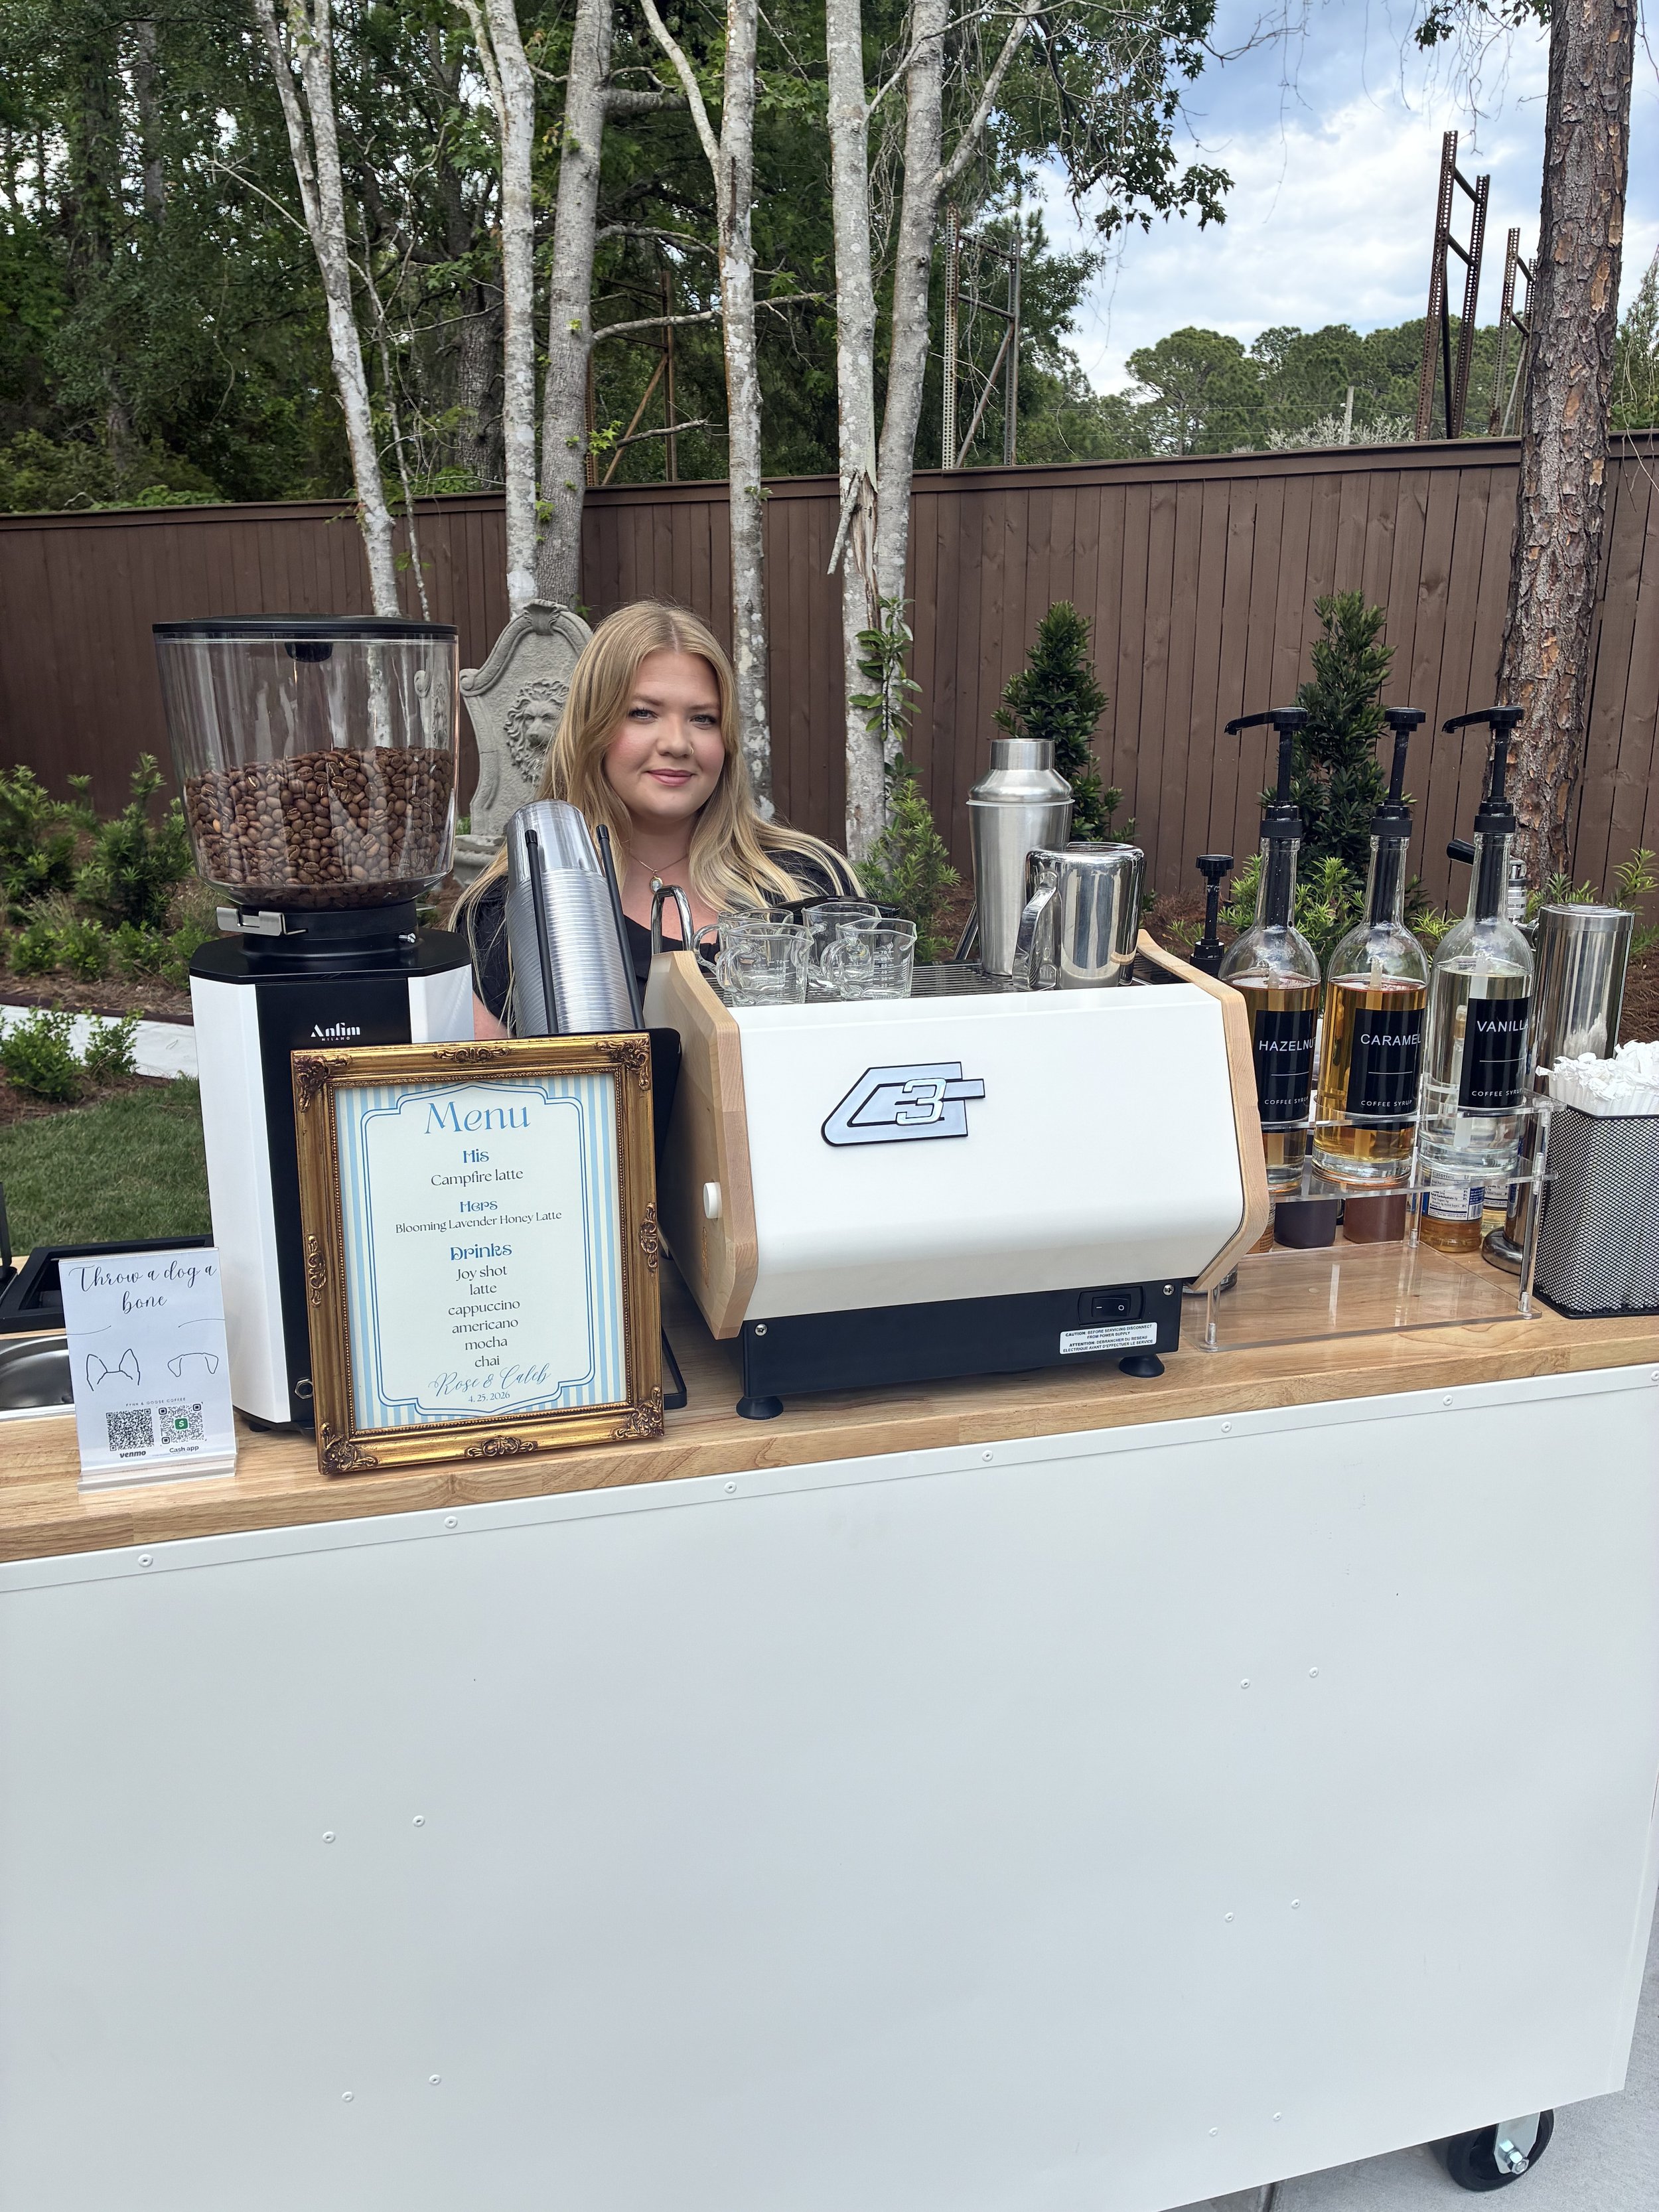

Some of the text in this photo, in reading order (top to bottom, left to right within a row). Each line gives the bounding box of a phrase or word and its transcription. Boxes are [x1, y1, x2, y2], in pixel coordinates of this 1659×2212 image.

[1360, 1033, 1421, 1046] CARAMEL
[424, 1101, 532, 1134] Menu
[463, 1148, 490, 1163] His
[431, 1169, 524, 1187] Campfire latte
[460, 1201, 498, 1213] Hers
[396, 1211, 562, 1234] Blooming Lavender Honey Latte
[450, 1242, 512, 1261] Drinks
[68, 1260, 217, 1292] Throw a dog a
[456, 1265, 508, 1281] Joy shot
[470, 1284, 497, 1295] latte
[122, 1290, 167, 1315] bone
[448, 1300, 520, 1317] cappuccino
[452, 1319, 518, 1334] americano
[465, 1336, 508, 1351] mocha
[474, 1355, 500, 1367] chai
[428, 1363, 551, 1397] Rose & Caleb
